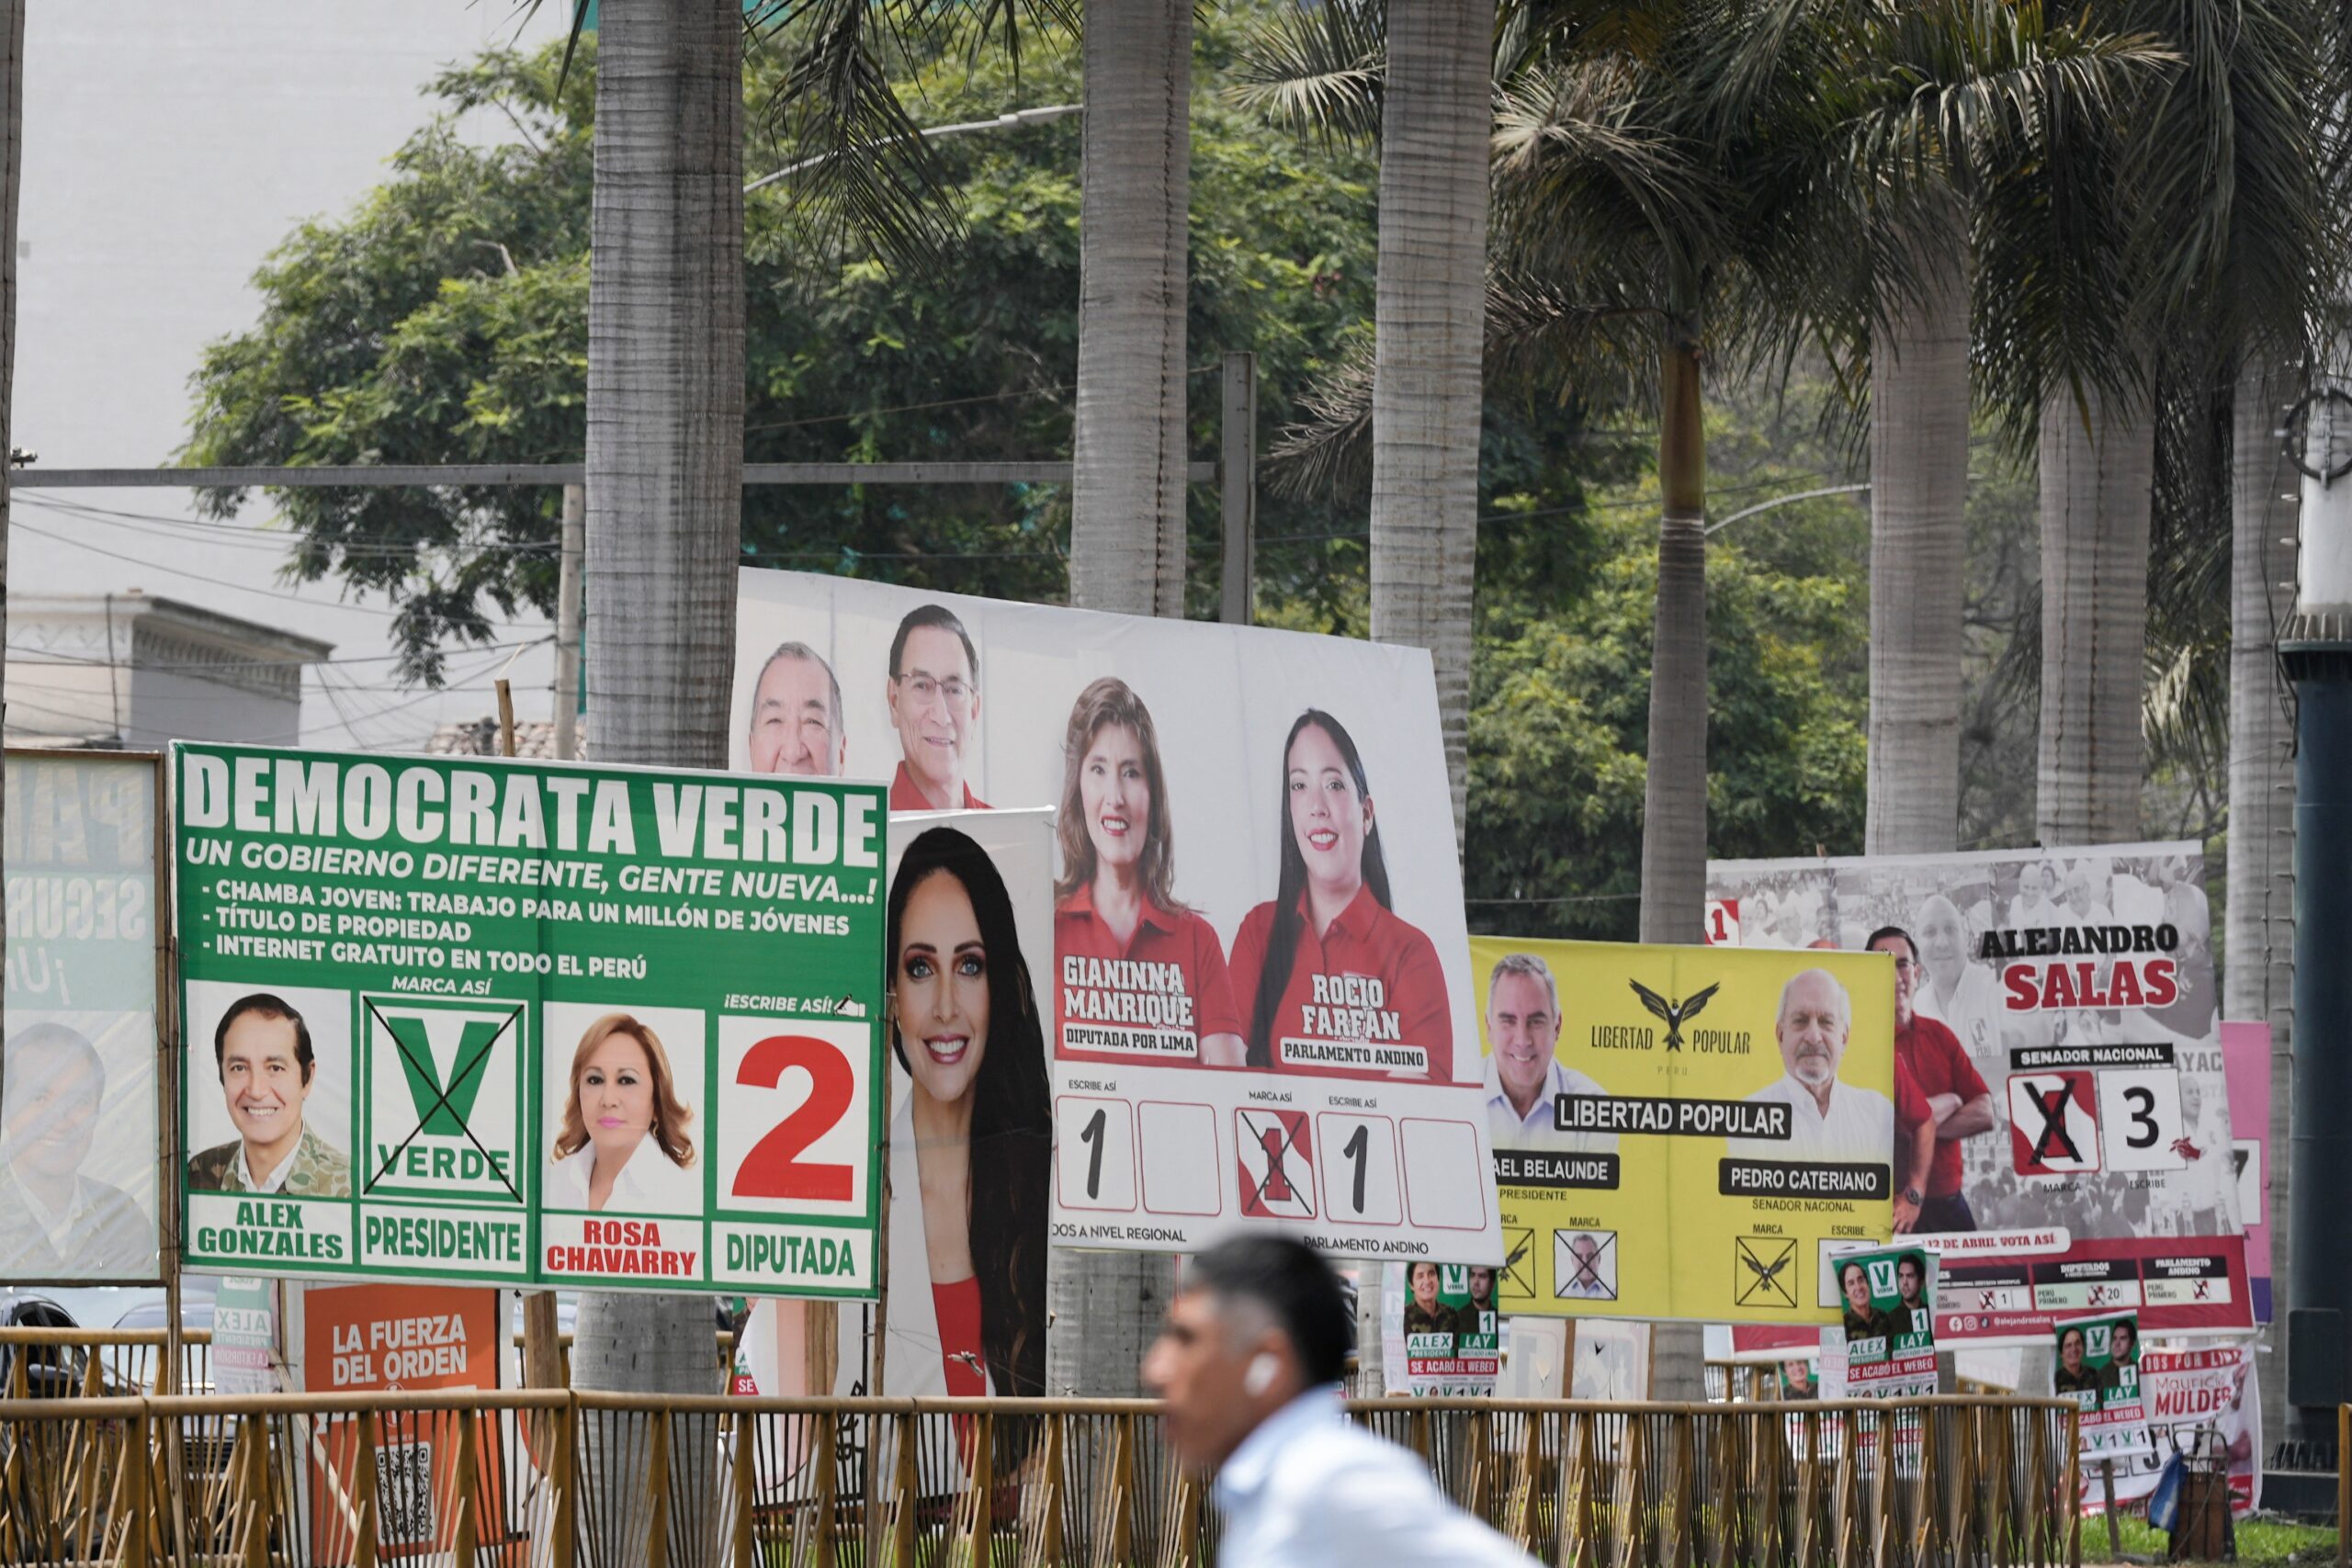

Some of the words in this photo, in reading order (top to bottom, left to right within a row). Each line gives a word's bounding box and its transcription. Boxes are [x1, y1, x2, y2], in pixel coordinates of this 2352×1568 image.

[184, 753, 637, 855] DEMOCRATA
[652, 782, 879, 868] VERDE
[186, 837, 233, 866] UN
[241, 840, 413, 879] GOBIERNO
[422, 852, 609, 896] DIFERENTE,
[618, 863, 723, 897] GENTE
[730, 871, 878, 905] NUEVA...!
[216, 879, 314, 905] CHAMBA
[320, 885, 401, 909] JOVEN:
[407, 888, 515, 918] TRABAJO
[522, 898, 582, 921] PARA
[588, 904, 618, 923] UN
[625, 901, 708, 929] MILLÓN
[714, 909, 744, 930] DE
[749, 907, 850, 936] JÓVENES
[216, 903, 295, 931] TÍTULO
[301, 912, 332, 933] DE
[337, 917, 471, 942] PROPIEDAD
[1712, 908, 1728, 941] 1
[1979, 923, 2180, 960] ALEJANDRO
[216, 934, 325, 962] INTERNET
[331, 942, 446, 967] GRATUITO
[451, 949, 481, 969] EN
[487, 951, 552, 975] TODO
[558, 955, 583, 976] EL
[588, 953, 647, 979] PERÚ
[1063, 955, 1184, 993] GIANINNA
[2004, 958, 2180, 1010] SALAS
[391, 976, 457, 994] MARCA
[460, 977, 492, 996] ASÍ
[1311, 974, 1384, 1009] ROCIO
[724, 994, 796, 1013] ¡ESCRIBE
[799, 996, 832, 1014] ASÍ!
[1063, 987, 1194, 1029] MANRIQUE
[1066, 1028, 1129, 1047] DIPUTADA
[1132, 1032, 1158, 1049] POR
[1160, 1035, 1194, 1052] LIMA
[1591, 1025, 1653, 1050] LIBERTAD
[1692, 1029, 1750, 1055] POPULAR
[1284, 1043, 1371, 1063] PARLAMENTO
[1375, 1049, 1424, 1066] ANDINO
[2021, 1049, 2090, 1066] SENADOR
[2093, 1047, 2164, 1063] NACIONAL
[387, 1016, 501, 1137] V
[1069, 1079, 1102, 1091] ESCRIBE
[1103, 1080, 1117, 1092] ASÍ
[1249, 1090, 1278, 1102] MARCA
[1279, 1091, 1293, 1103] ASÍ
[1329, 1096, 1363, 1107] ESCRIBE
[1363, 1097, 1377, 1109] ASÍ
[731, 1035, 854, 1201] 2
[1560, 1099, 1673, 1130] LIBERTAD
[1679, 1103, 1785, 1134] POPULAR
[2122, 1087, 2159, 1148] 3
[378, 1143, 510, 1180] VERDE
[1080, 1108, 1107, 1201] 1
[1261, 1128, 1292, 1201] 1
[1343, 1123, 1369, 1214] 1
[1523, 1159, 1608, 1180] BELAUNDE
[1731, 1168, 1784, 1189] PEDRO
[1788, 1169, 1877, 1191] CATERIANO
[2043, 1181, 2081, 1193] MARCA
[2129, 1179, 2166, 1189] ESCRIBE
[1499, 1189, 1567, 1201] PRESIDENTE
[235, 1201, 304, 1229] ALEX
[1752, 1199, 1801, 1212] SENADOR
[1804, 1200, 1855, 1213] NACIONAL
[1569, 1216, 1600, 1227] MARCA
[1752, 1224, 1783, 1235] MARCA
[1831, 1225, 1865, 1236] ESCRIBE
[198, 1226, 343, 1259] GONZALES
[366, 1216, 521, 1262] PRESIDENTE
[583, 1220, 662, 1247] ROSA
[1079, 1225, 1088, 1238] A
[1090, 1225, 1125, 1239] NIVEL
[1126, 1227, 1187, 1243] REGIONAL
[1943, 1238, 1958, 1248] DE
[1962, 1237, 1996, 1248] ABRIL
[2000, 1235, 2031, 1247] VOTA
[727, 1233, 855, 1277] DIPUTADA
[1304, 1236, 1379, 1252] PARLAMENTO
[1383, 1240, 1429, 1255] ANDINO
[547, 1245, 696, 1276] CHAVARRY
[1447, 1264, 1462, 1283] V
[1873, 1264, 1889, 1288] V
[2038, 1296, 2067, 1304] PRIMERO
[2107, 1288, 2120, 1300] 20
[1483, 1314, 1491, 1332] 1
[1915, 1312, 1925, 1330] 1
[333, 1325, 364, 1354] LA
[370, 1314, 466, 1349] FUERZA
[1410, 1335, 1451, 1348] ALEX
[1465, 1335, 1491, 1348] LAY
[1900, 1334, 1925, 1348] LAY
[2090, 1329, 2105, 1347] V
[1849, 1340, 1883, 1355] ALEX
[333, 1354, 378, 1386] DEL
[384, 1345, 467, 1381] ORDEN
[1411, 1362, 1423, 1373] SE
[1426, 1359, 1455, 1373] ACABÓ
[1456, 1362, 1465, 1373] EL
[1467, 1361, 1495, 1373] WEBEO
[1849, 1368, 1860, 1379] SE
[1861, 1362, 1891, 1378] ACABÓ
[1892, 1364, 1902, 1374] EL
[1904, 1358, 1934, 1372] WEBEO
[2175, 1353, 2202, 1370] POR
[2123, 1368, 2132, 1384] 1
[2109, 1387, 2133, 1400] LAY
[2104, 1412, 2112, 1422] EL
[2114, 1407, 2141, 1420] WEBEO
